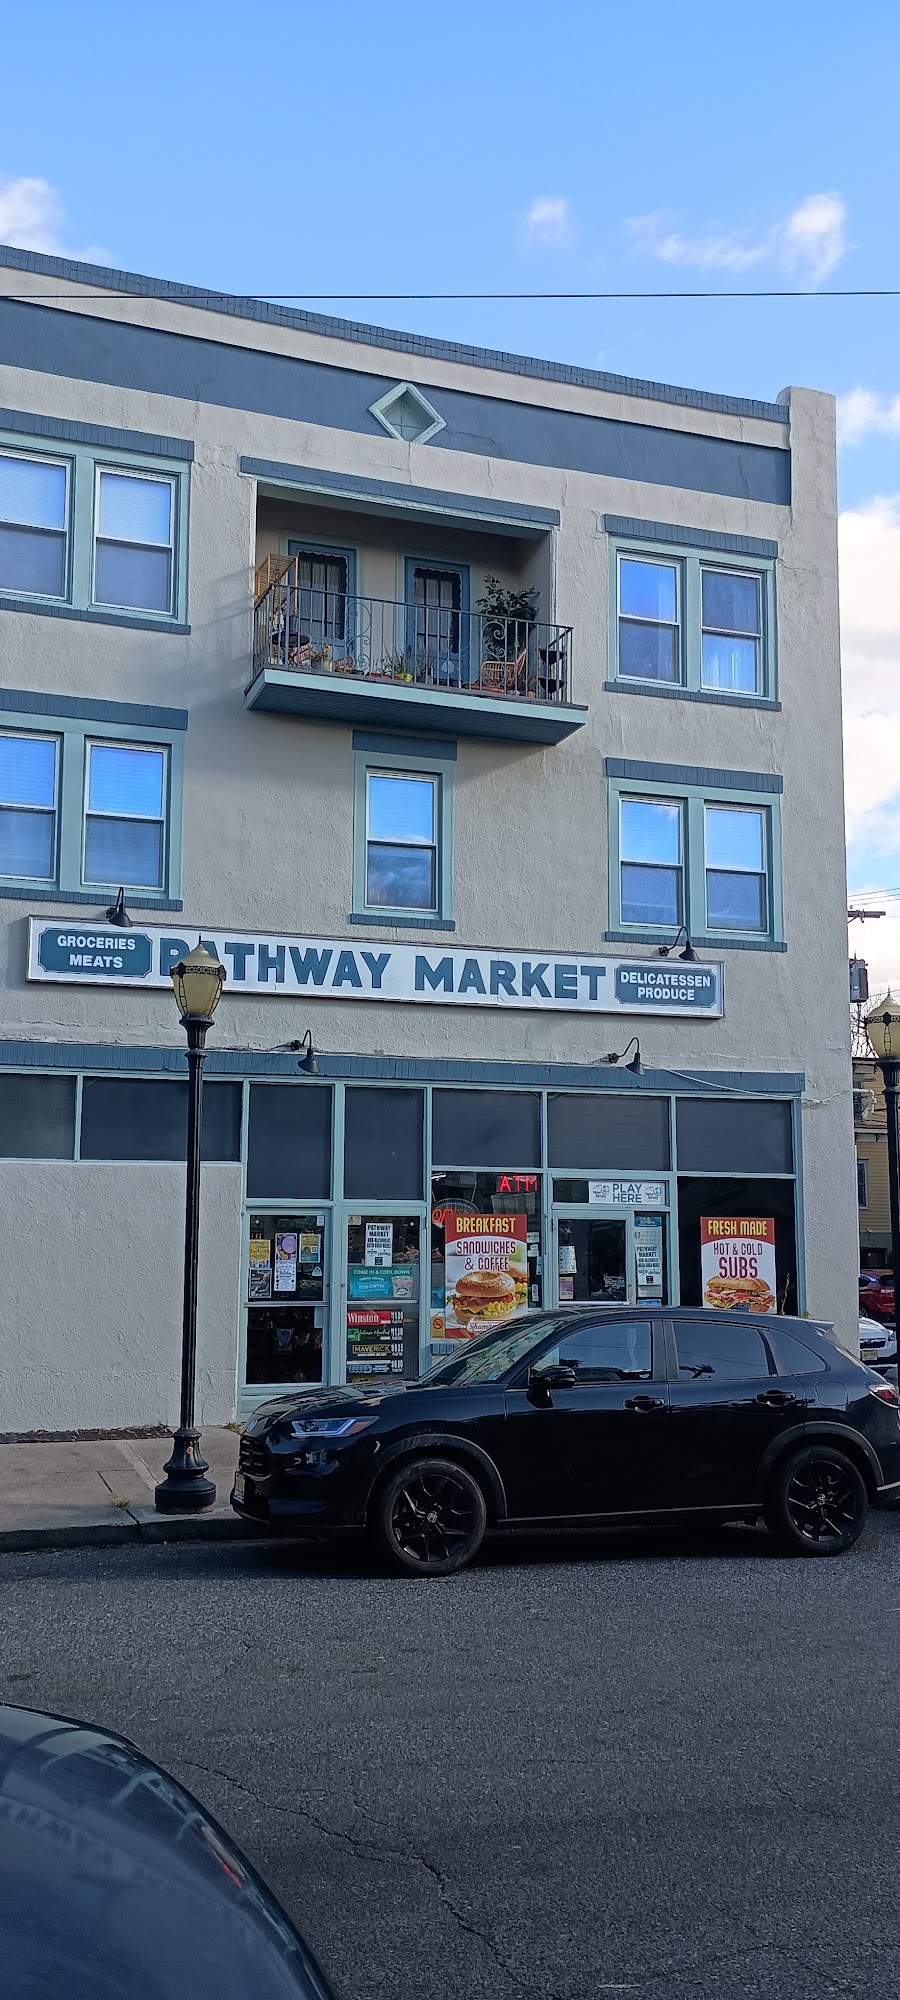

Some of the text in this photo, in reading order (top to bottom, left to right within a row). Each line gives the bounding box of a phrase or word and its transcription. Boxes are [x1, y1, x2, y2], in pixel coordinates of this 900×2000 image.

[57, 934, 136, 950] GROCERIES
[69, 953, 123, 969] MEATS
[414, 955, 606, 1001] MARKET
[620, 971, 711, 987] DELICATESSEN
[637, 986, 695, 1001] PRODUCE
[500, 1175, 538, 1192] ATM
[612, 1183, 642, 1194] PLAY
[612, 1193, 642, 1203] HERE
[456, 1217, 515, 1233] BREAKFAST
[708, 1220, 767, 1236] FRESH MADE
[456, 1241, 516, 1255] SANDWICHES
[713, 1243, 763, 1256] HOT & COLD
[464, 1256, 509, 1271] & COFFEE
[719, 1257, 758, 1278] SUBS
[347, 1312, 379, 1323] Winston
